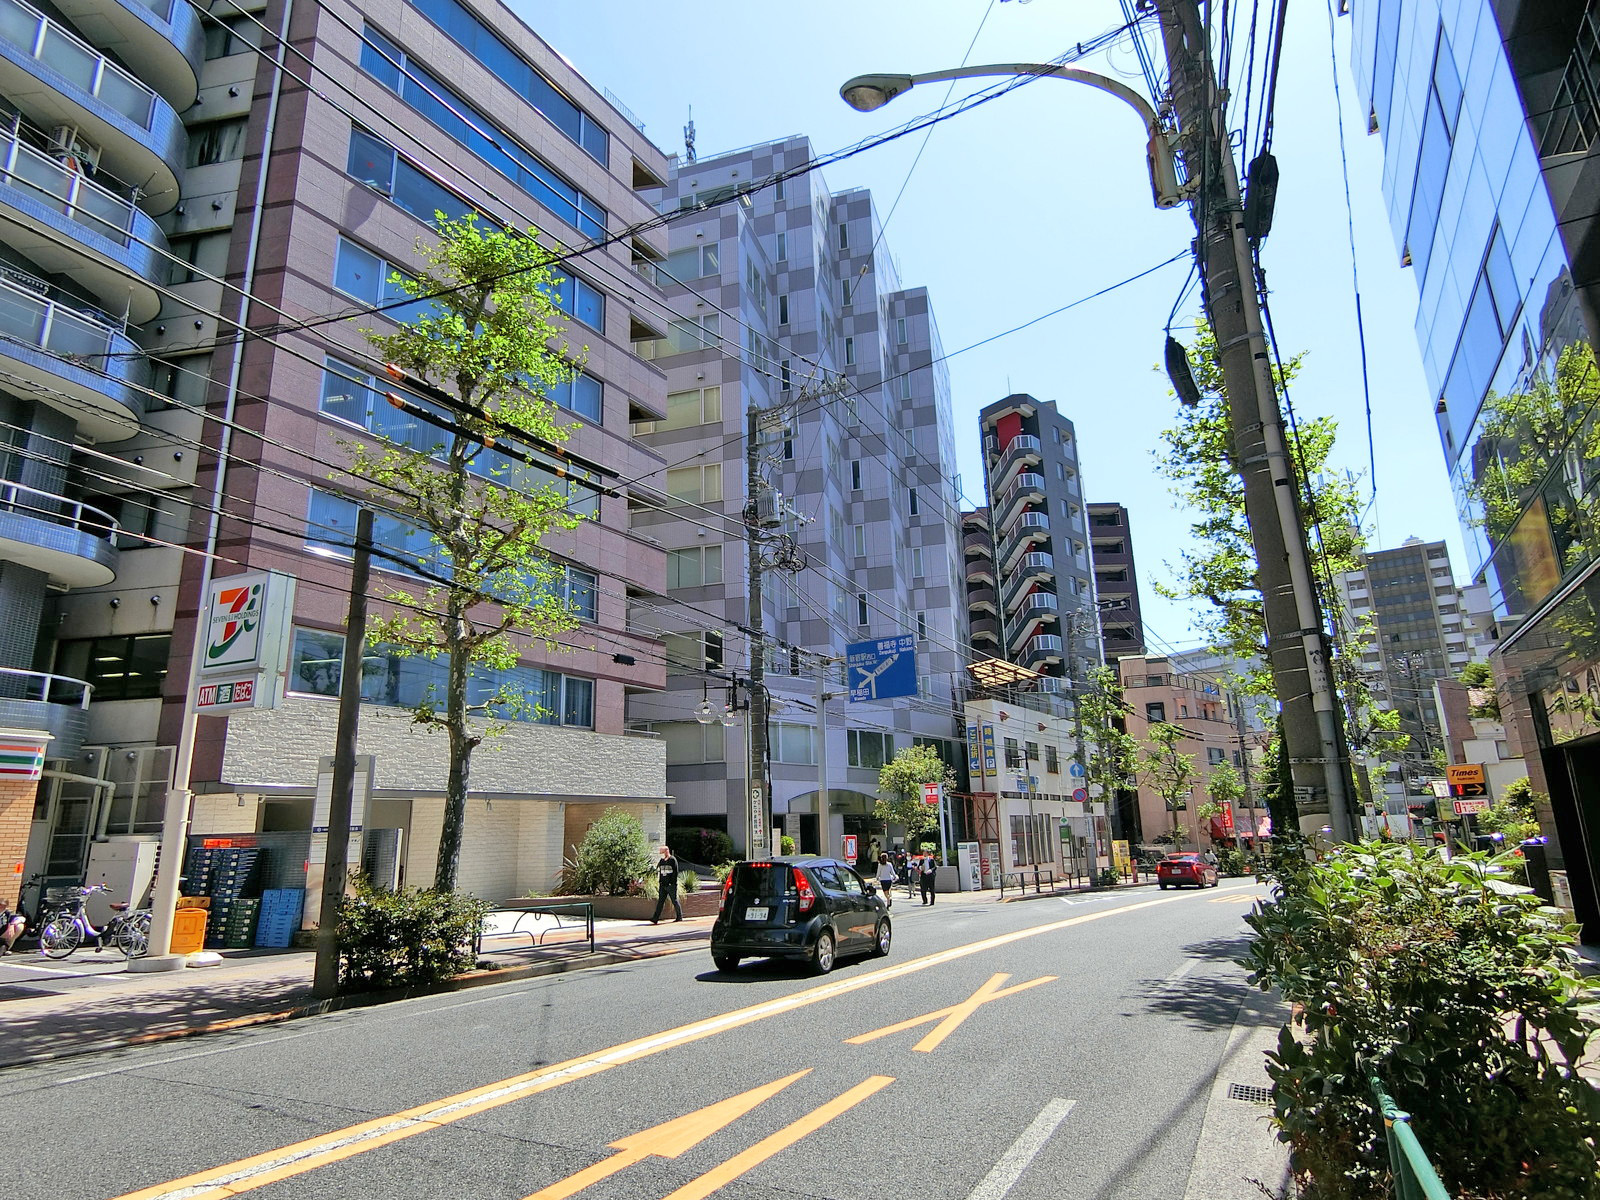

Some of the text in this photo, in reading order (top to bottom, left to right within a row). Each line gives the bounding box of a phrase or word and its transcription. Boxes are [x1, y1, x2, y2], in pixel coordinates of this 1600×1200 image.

[898, 637, 913, 646] 中野
[199, 687, 216, 704] ATM
[219, 685, 232, 702] 酒
[235, 683, 252, 700] たばこ
[850, 688, 869, 697] 早稲田
[1451, 769, 1479, 777] Times
